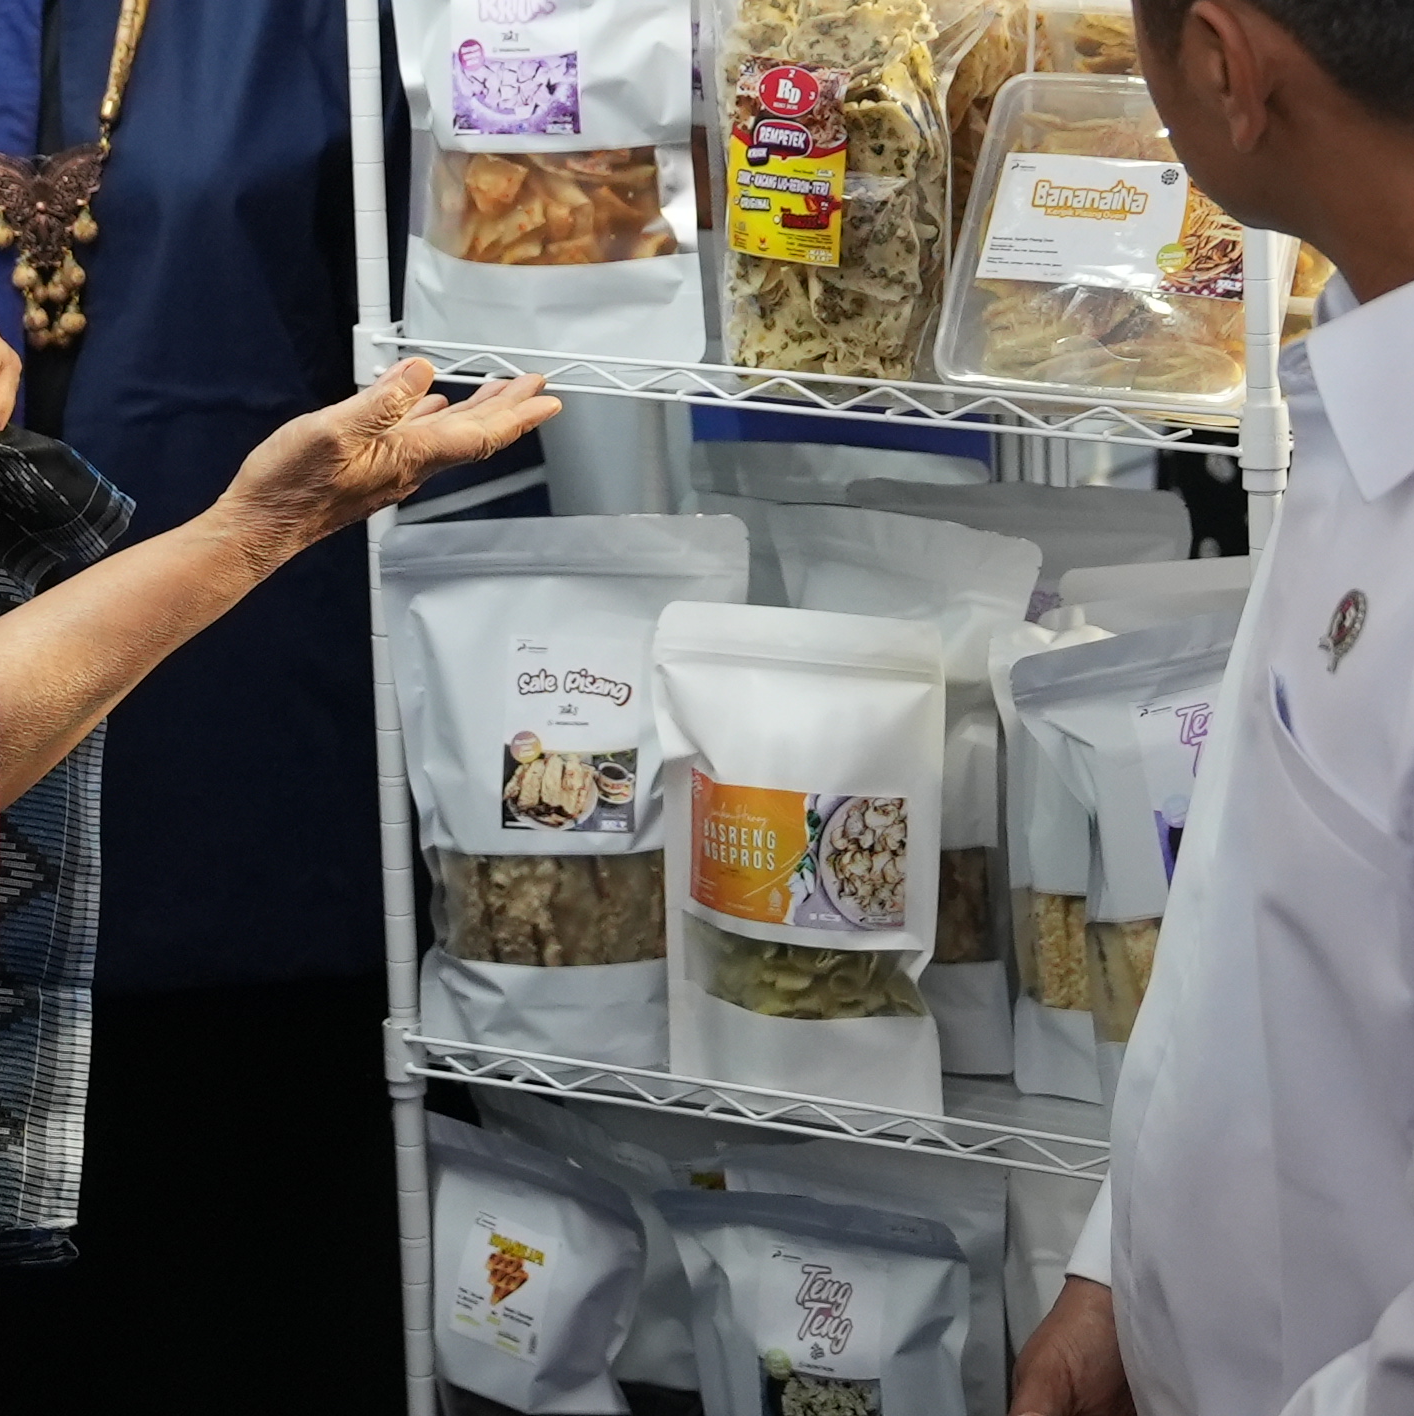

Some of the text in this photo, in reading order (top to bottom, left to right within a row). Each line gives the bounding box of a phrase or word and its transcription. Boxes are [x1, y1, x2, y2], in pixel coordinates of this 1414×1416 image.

[788, 69, 796, 78] 2
[776, 78, 802, 104] RD
[758, 126, 807, 149] REMPEYEK
[518, 668, 633, 706] Sale Pisang
[796, 1263, 853, 1318] Teng
[797, 1300, 854, 1355] Teng
